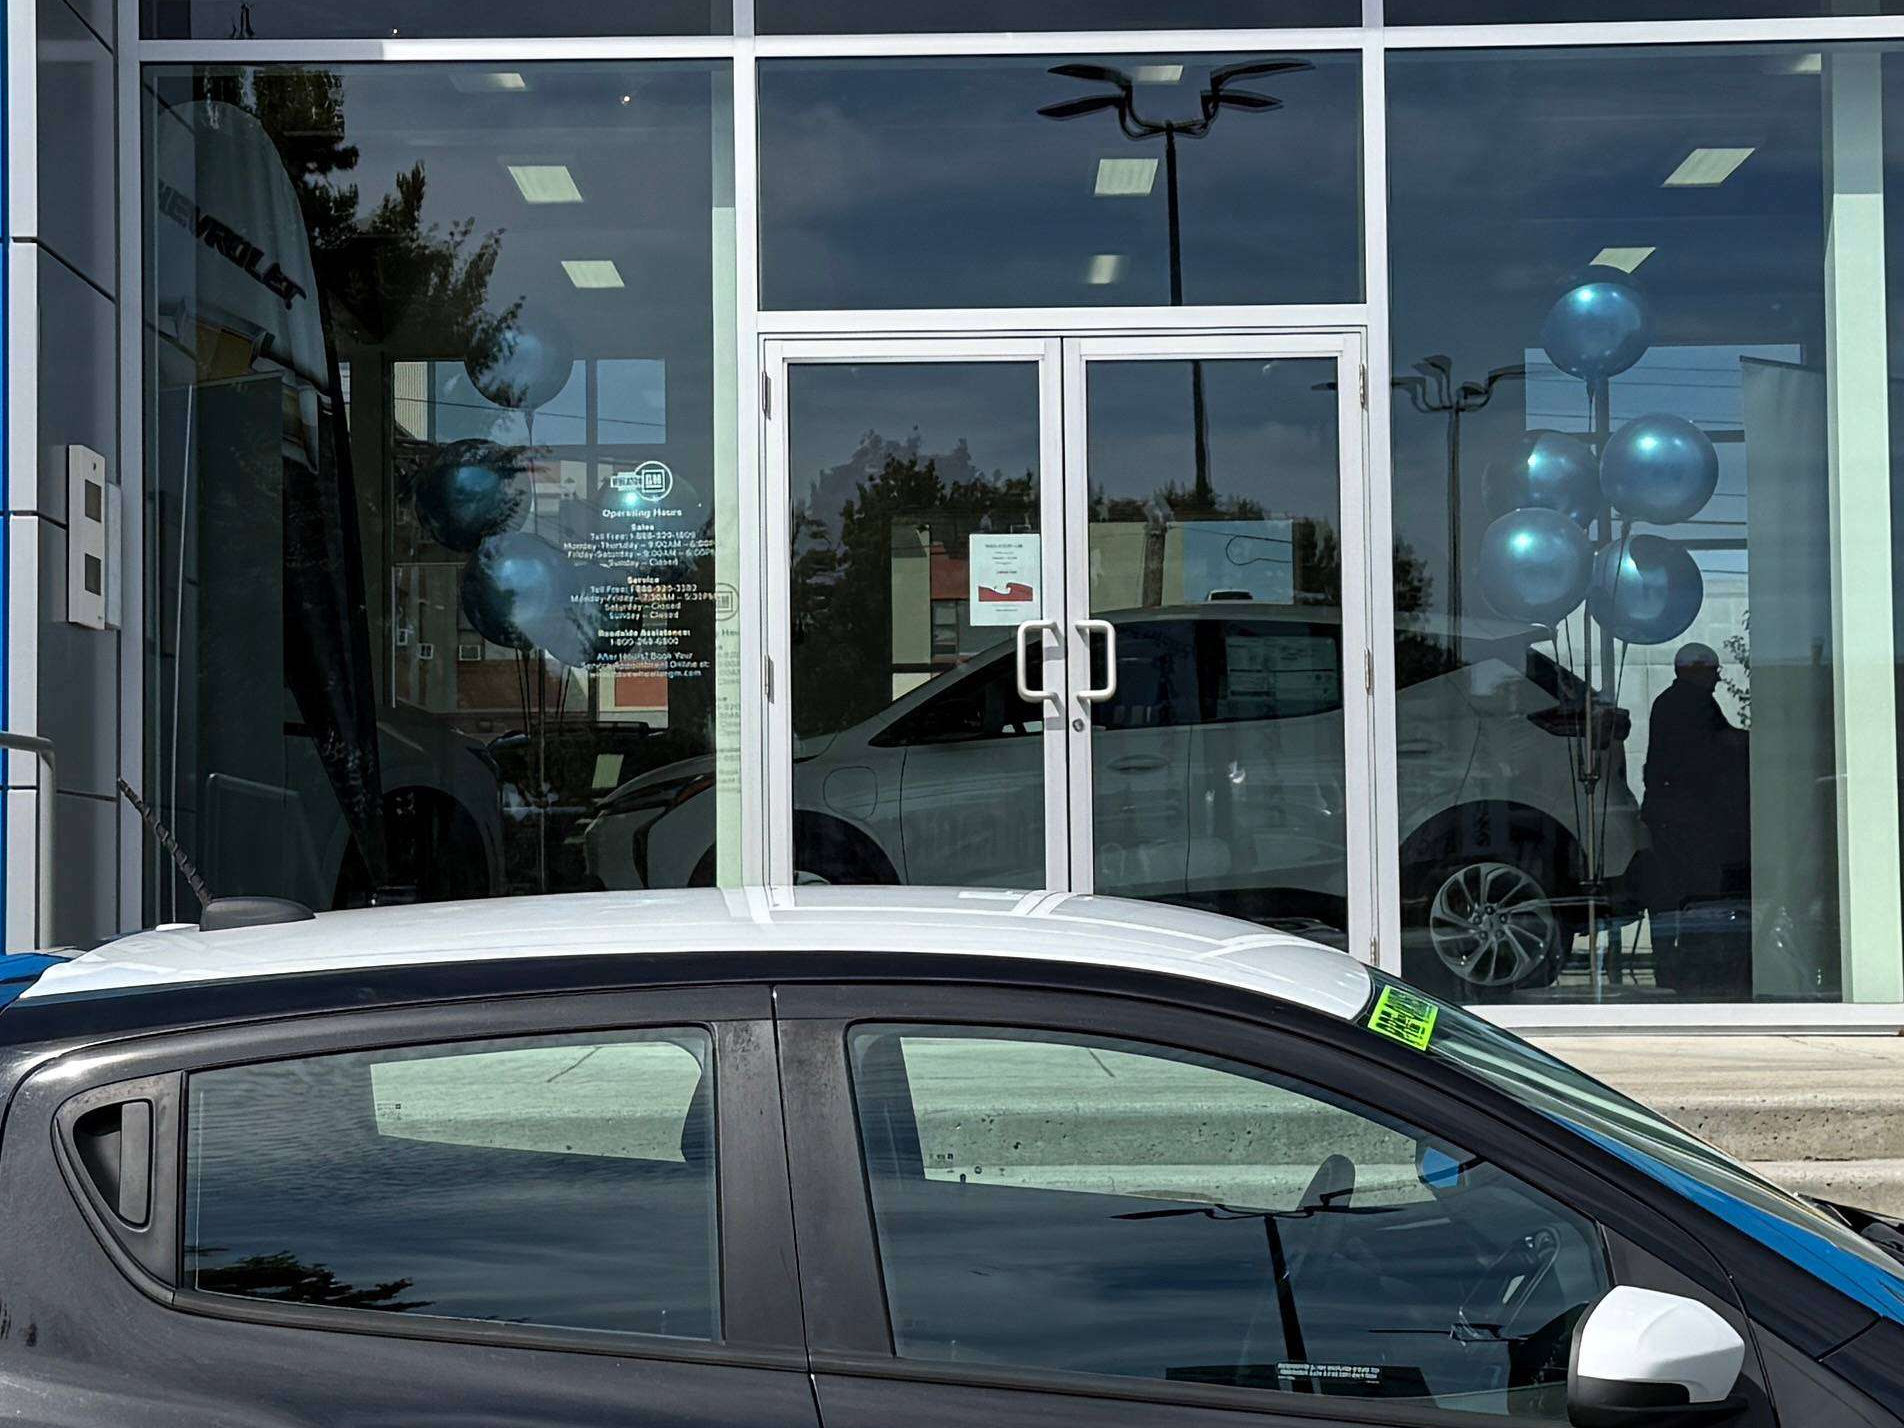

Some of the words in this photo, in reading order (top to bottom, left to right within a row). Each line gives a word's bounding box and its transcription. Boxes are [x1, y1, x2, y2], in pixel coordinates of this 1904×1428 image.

[158, 178, 307, 310] HEVROLET
[602, 508, 650, 518] Operating
[653, 508, 682, 517] Hours
